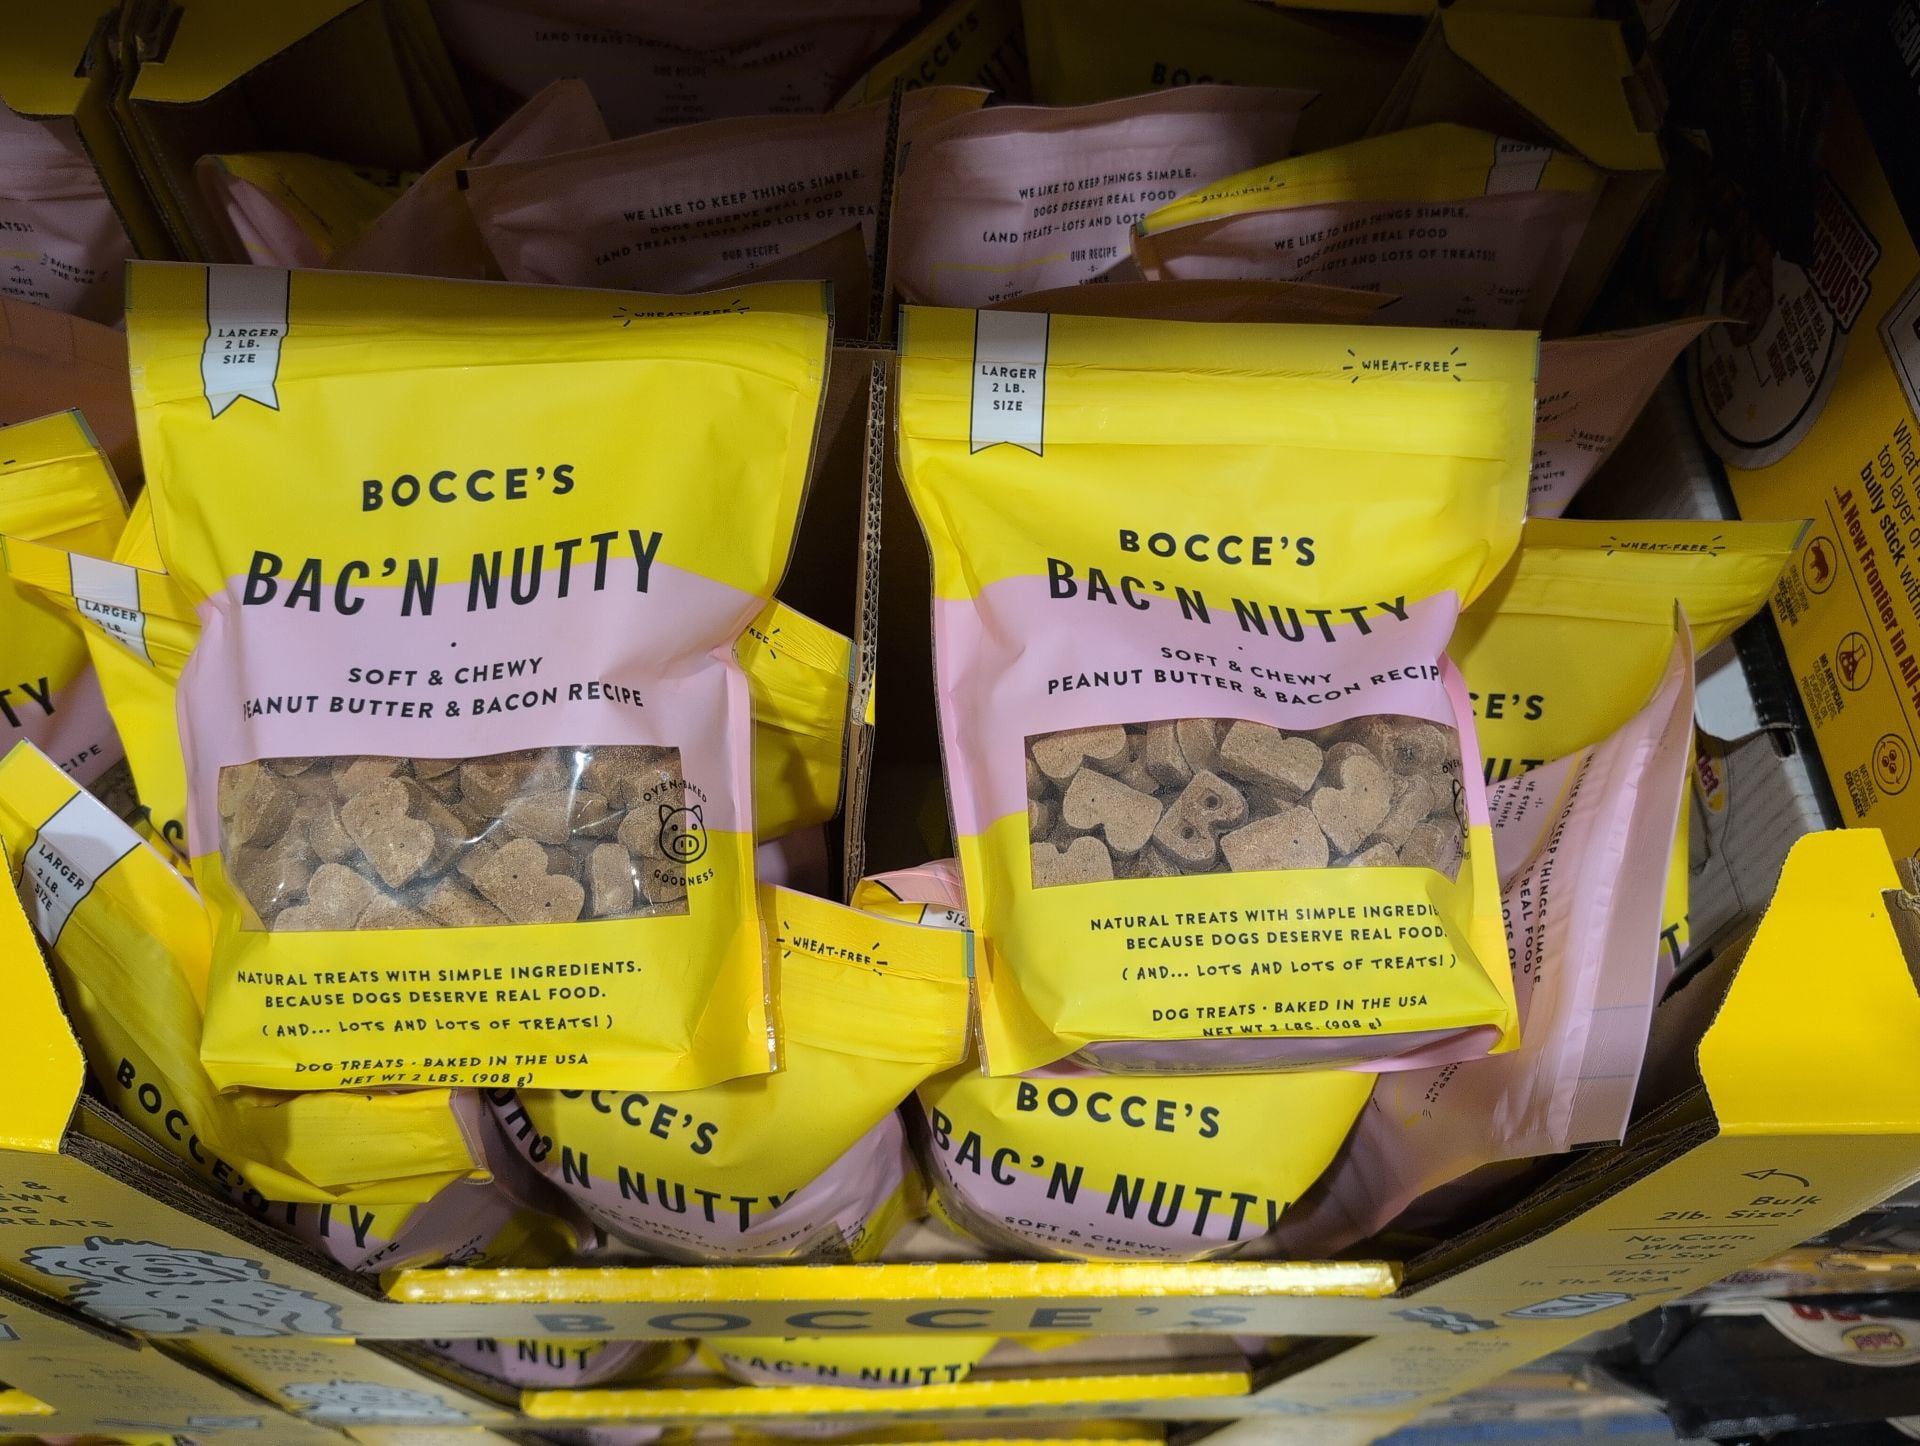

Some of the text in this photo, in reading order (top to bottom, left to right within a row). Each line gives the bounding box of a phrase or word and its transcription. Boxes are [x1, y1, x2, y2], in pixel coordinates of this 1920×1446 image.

[624, 168, 864, 222] WE LIKE TO KEEP THINGS SIMPLE.
[1019, 167, 1197, 200] WE LIKE TO KEEP THINGS SIMPLE.
[1033, 188, 1176, 218] DOGS DESERVE REAL FOOD
[777, 207, 836, 229] LOTS OF
[983, 215, 1112, 244] (AND AND
[1274, 224, 1341, 250] WE LIKE TO
[1371, 226, 1448, 242] REAL FOOD
[721, 243, 780, 261] OUR RECIPE
[1070, 246, 1117, 263] OUR RECIPE
[1351, 249, 1438, 267] AND LOTS OF
[634, 308, 732, 318] WHEAT-FREE
[218, 329, 279, 338] LARGER
[225, 338, 260, 349] 2 LB.
[223, 354, 257, 364] SIZE
[1361, 358, 1452, 373] WHEAT-FREE
[981, 365, 1038, 380] LARGER
[991, 383, 1026, 394] 2 LB.
[992, 399, 1024, 412] SIZE
[1892, 418, 1918, 477] What
[362, 464, 575, 512] BOCCE'S
[1876, 444, 1914, 529] top layer
[1860, 460, 1905, 568] bully stick
[1119, 529, 1316, 567] BOCCE'S
[1620, 541, 1710, 553] WHEAT-FREE
[242, 529, 663, 617] BAC'N NUTTY
[1844, 505, 1898, 633] New Frontier
[85, 600, 137, 622] LARGER
[1047, 557, 1411, 644] BAC'N NUTTY
[348, 657, 543, 687] SOFT & CHEWY
[1161, 647, 1333, 687] SOFT & CHEWY
[1047, 664, 1439, 706] PEANUT BUTTER & BACON RECIP
[1824, 668, 1846, 714] ARTIFICIAL
[329, 681, 644, 719] BUTTER & BACON RECIPE
[1488, 784, 1505, 812] RECIPE
[38, 843, 86, 892] LARGER
[653, 867, 716, 888] GOODNESS
[1537, 822, 1565, 919] KEEP THINGS
[34, 883, 54, 913] SIZE
[44, 873, 59, 899] LB.
[1519, 878, 1535, 921] REAL
[1090, 905, 1356, 930] NATURAL TREATS WITH SIMPLE
[1126, 924, 1449, 950] BECAUSE DOGS DESERVE REAL FOOD.
[1523, 926, 1533, 974] FOOD
[793, 936, 872, 965] WHEAT-FREE
[238, 960, 642, 986] NATURAL TREATS WITH SIMPLE INGREDIENTS.
[1197, 956, 1444, 977] LOTS AND LOTS OF TREATS!
[265, 985, 607, 1008] BECAUSE DOGS DESERVE REAL FOOD.
[1152, 995, 1428, 1022] DOG TREATS BAKED IN THE USA
[338, 1016, 599, 1033] LOTS AND LOTS OF TREATS!
[1203, 1018, 1363, 1038] NET WT 2 (908
[295, 1053, 589, 1073] DOG TREATS BAKED IN THE USA
[340, 1070, 511, 1085] NET WT 2 LBS. (908
[1017, 1081, 1221, 1139] BOCCE'S
[931, 1107, 1084, 1205] BAC'N
[1749, 1195, 1822, 1206] Bulk
[1656, 1209, 1804, 1221] 2lb. Size!
[1004, 1215, 1172, 1253] SOFT CHEWY
[1625, 1234, 1756, 1244] No Corn,
[1643, 1243, 1736, 1251] Wheat,
[1677, 1251, 1724, 1261] Soy
[1557, 1277, 1605, 1285] The
[1607, 1268, 1691, 1276] Baked
[534, 1306, 1256, 1333] BOCCE'S
